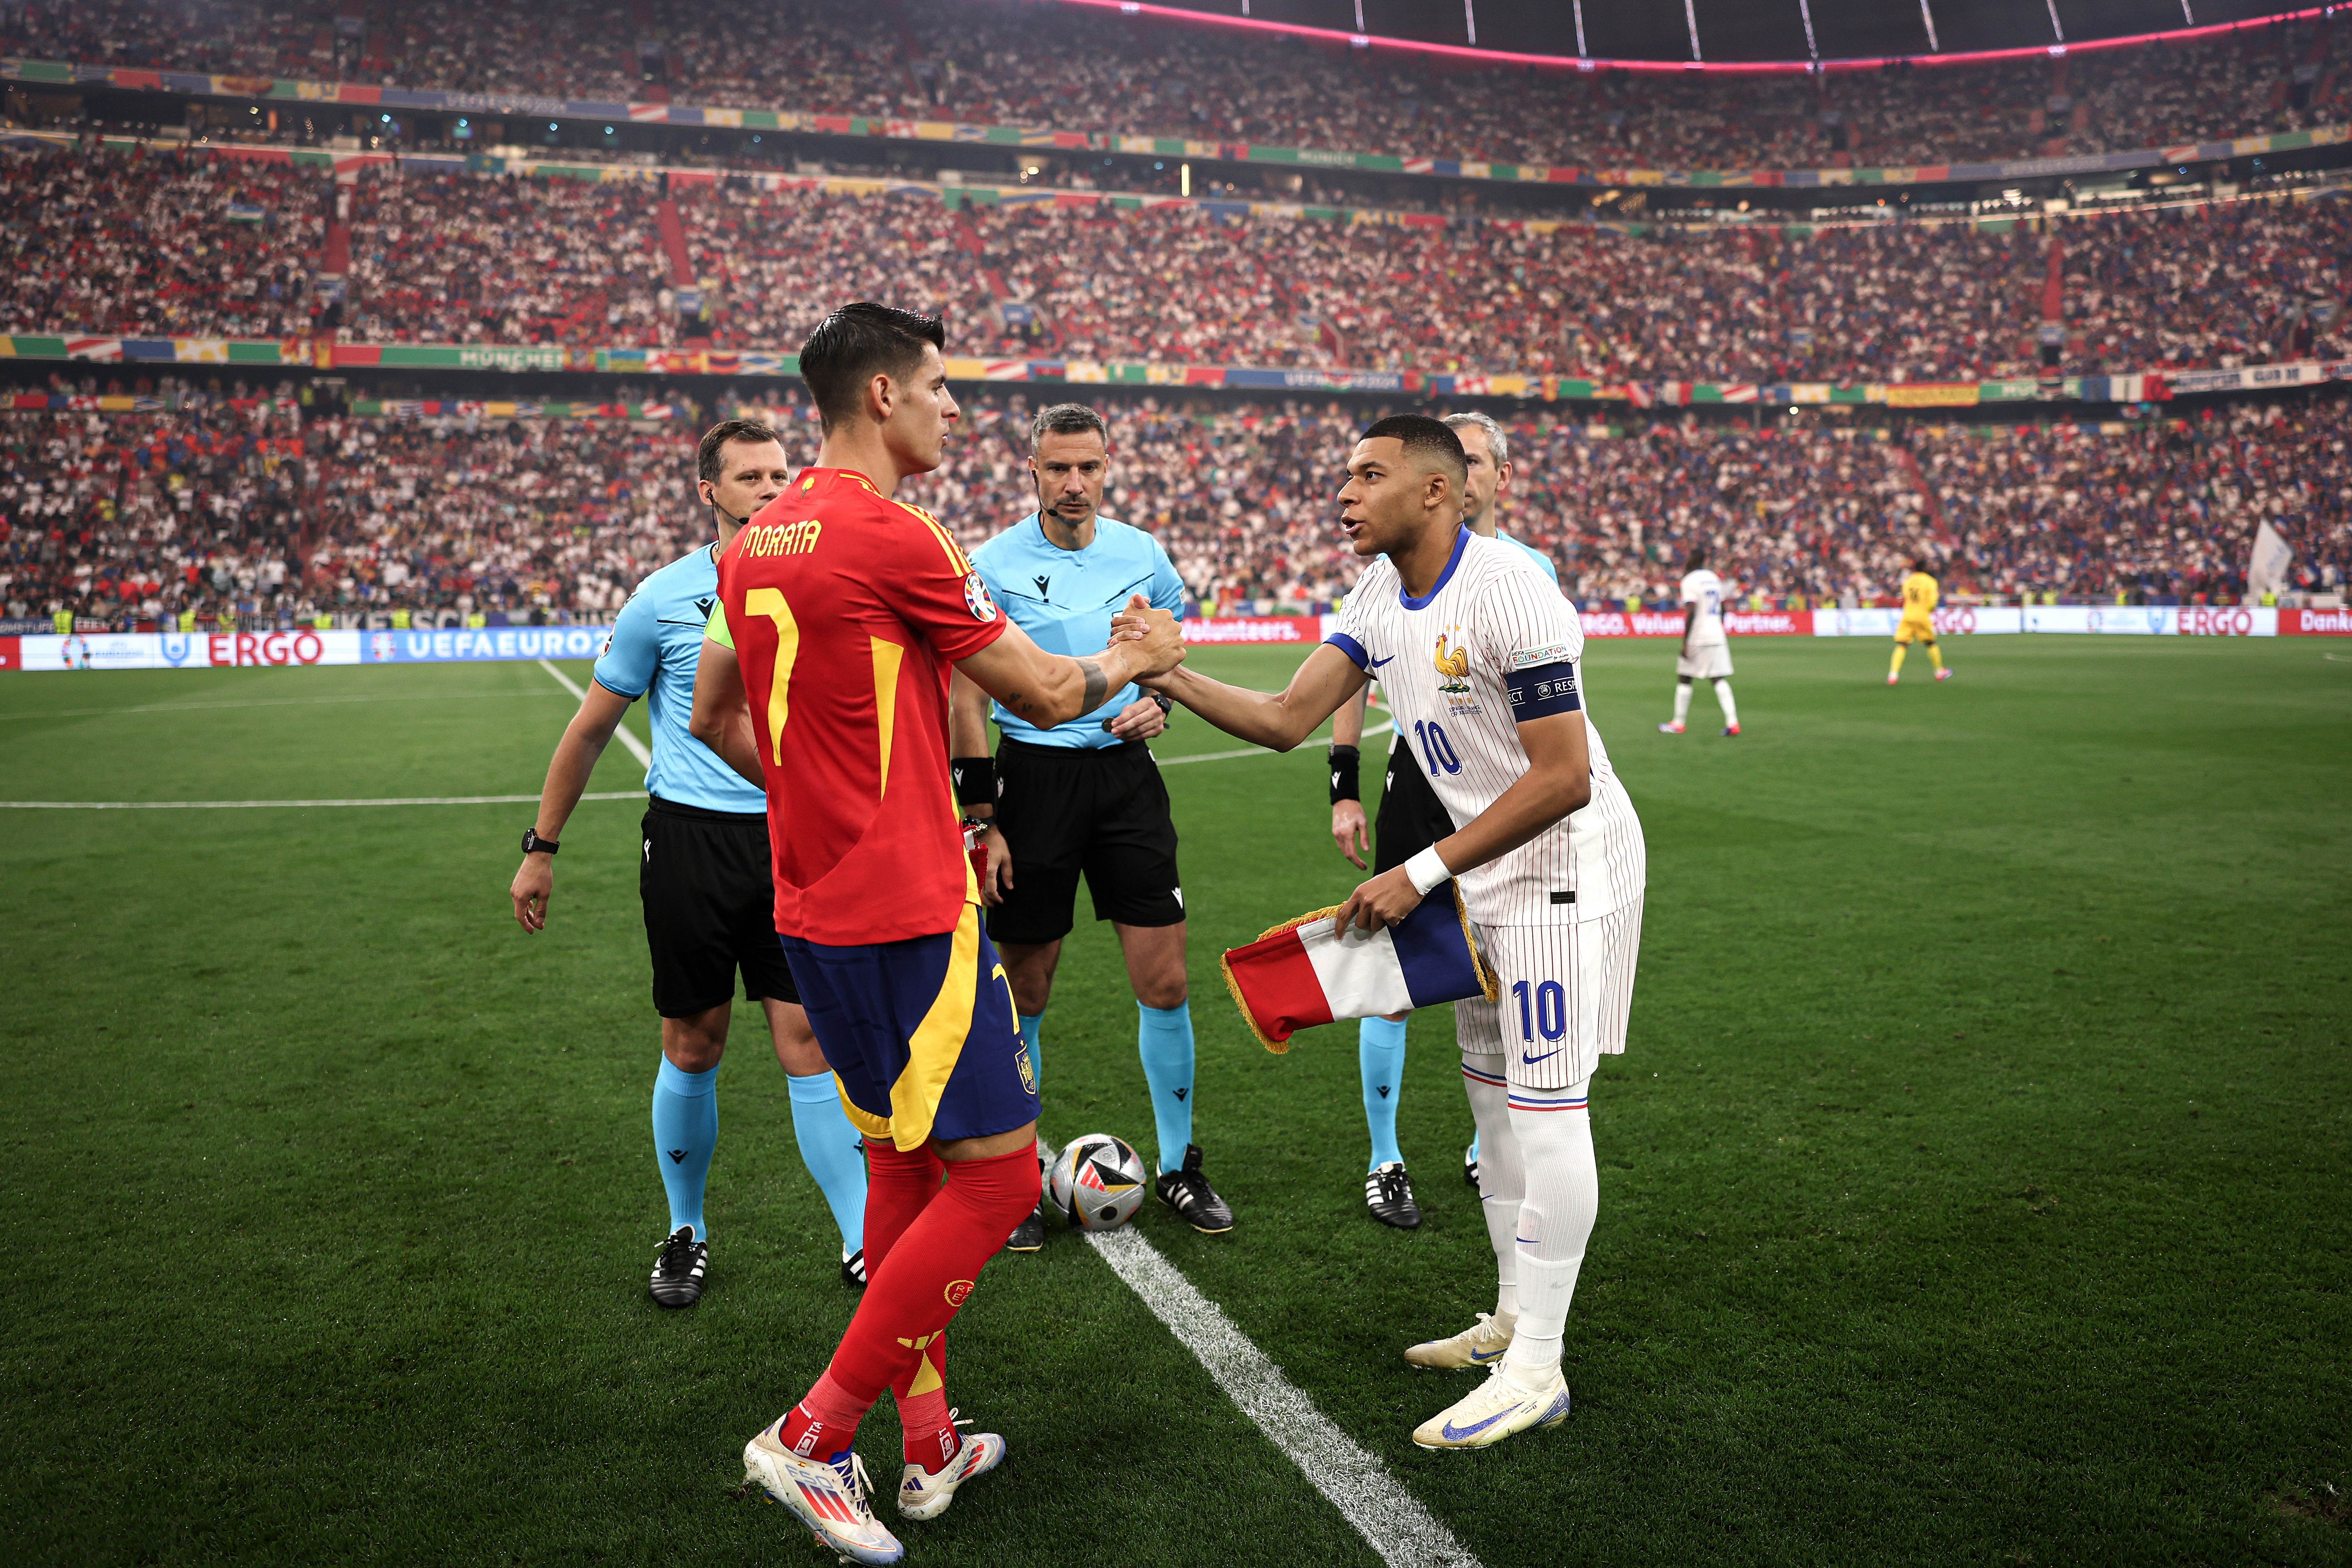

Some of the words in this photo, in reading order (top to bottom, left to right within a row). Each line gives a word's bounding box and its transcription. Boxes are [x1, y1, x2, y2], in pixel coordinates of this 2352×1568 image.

[739, 520, 822, 558] MORATA
[2179, 607, 2252, 636] ERGO
[209, 632, 323, 666] ERGO
[1513, 646, 1567, 663] FOUNDATION
[745, 588, 799, 767] 7
[1554, 680, 1577, 693] RESP
[1508, 691, 1522, 703] ECT
[1415, 719, 1462, 777] 10
[992, 963, 1020, 1035] 7
[1513, 980, 1566, 1043] 10
[785, 1464, 834, 1489] F50
